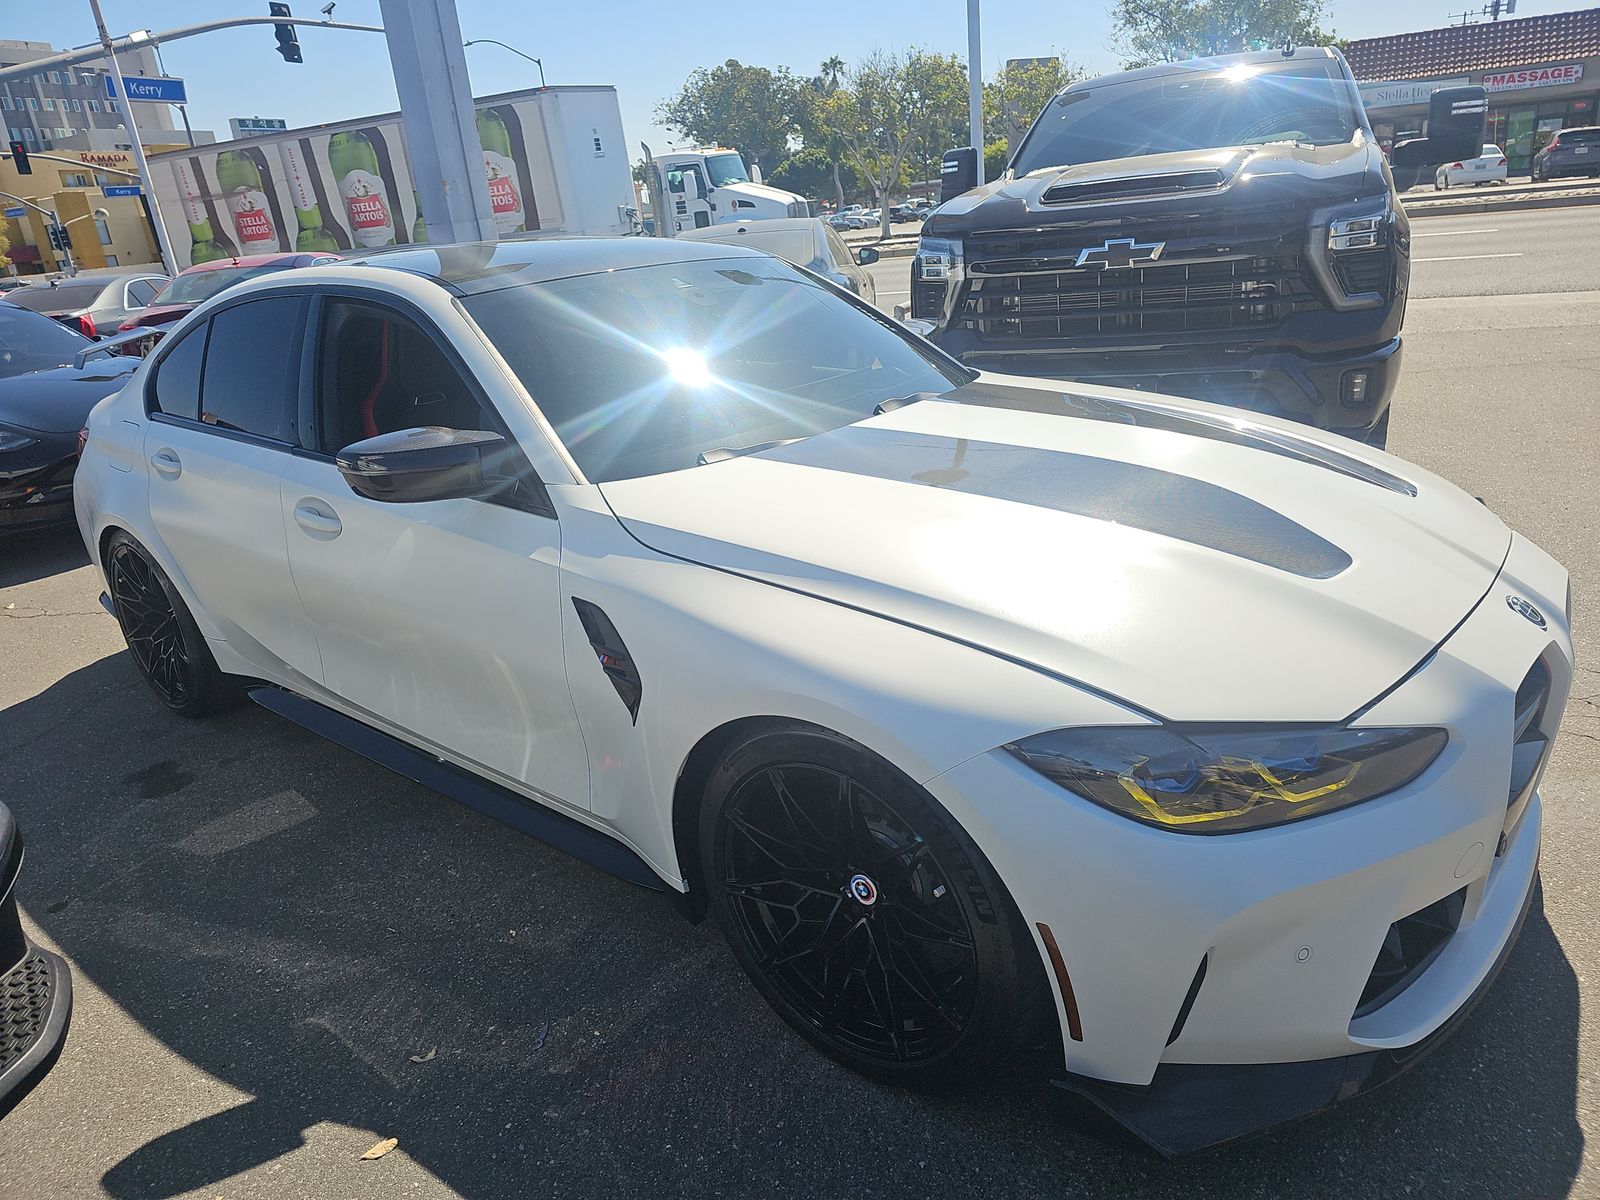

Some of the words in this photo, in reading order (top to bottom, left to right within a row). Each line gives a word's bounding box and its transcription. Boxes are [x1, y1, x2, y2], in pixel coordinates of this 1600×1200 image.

[1491, 66, 1574, 87] MASSAGE
[130, 82, 163, 98] Kerry
[1377, 88, 1409, 101] Stella
[80, 152, 129, 164] RAMADA
[489, 184, 512, 196] ELLA
[491, 194, 514, 206] TOIS
[351, 201, 382, 213] STELLA
[239, 216, 266, 226] STELLA
[354, 210, 384, 222] ARTOIS
[242, 225, 269, 236] ARTOIS
